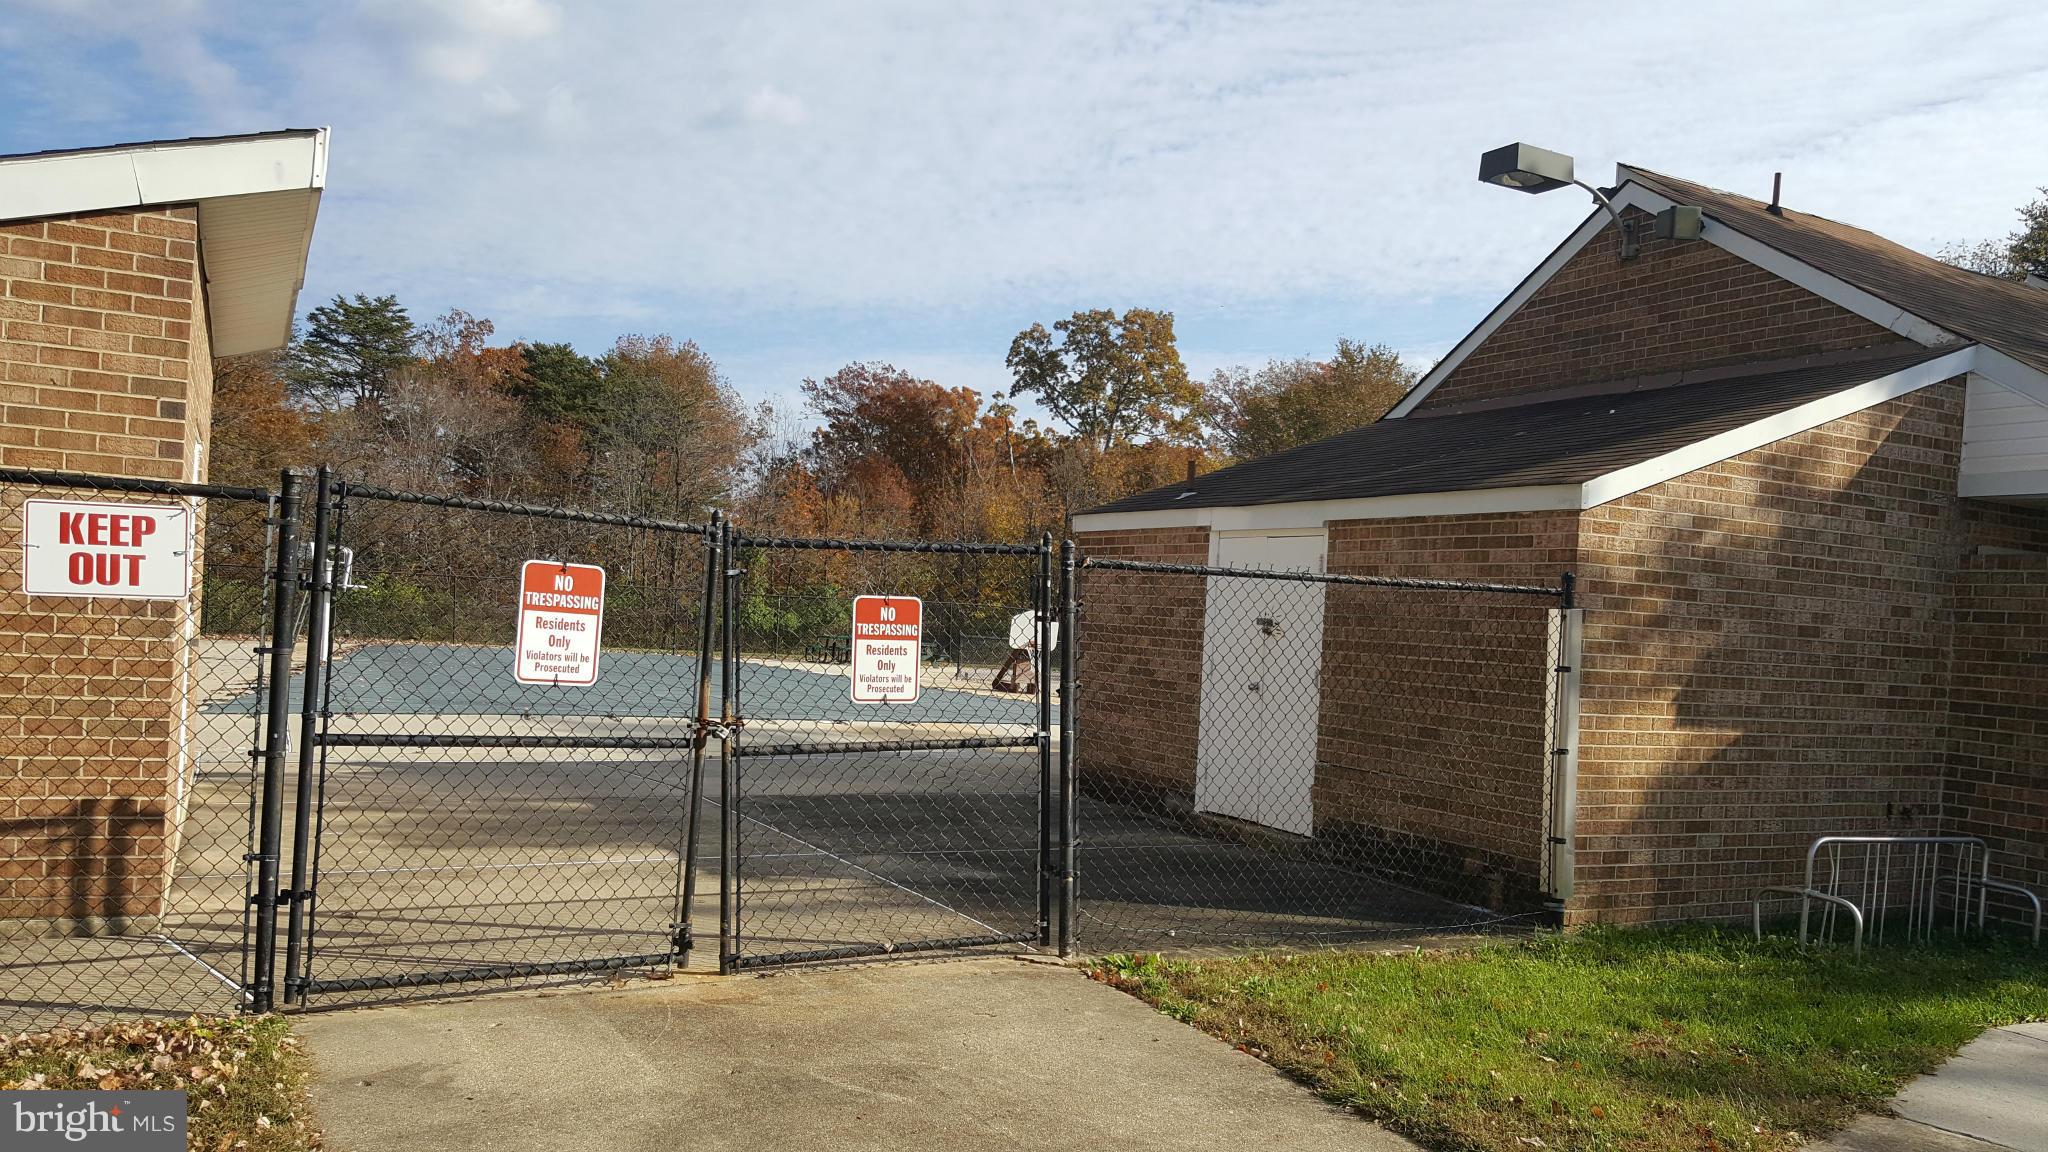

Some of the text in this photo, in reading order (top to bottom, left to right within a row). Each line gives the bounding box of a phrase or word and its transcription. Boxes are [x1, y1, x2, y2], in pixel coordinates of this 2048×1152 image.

[59, 511, 157, 547] KEEP
[68, 551, 147, 586] OUT
[554, 574, 574, 591] NO
[525, 591, 599, 610] TRESPASSING
[880, 606, 896, 622] NO
[535, 616, 586, 632] Residents
[856, 623, 918, 636] TRESPASSING
[548, 634, 571, 651] Only
[526, 650, 590, 663] Violators will be
[866, 644, 908, 656] Residents
[534, 662, 580, 674] Prosecuted
[877, 660, 896, 673] Only
[859, 674, 912, 683] Violators will be
[867, 684, 905, 693] Prosecuted
